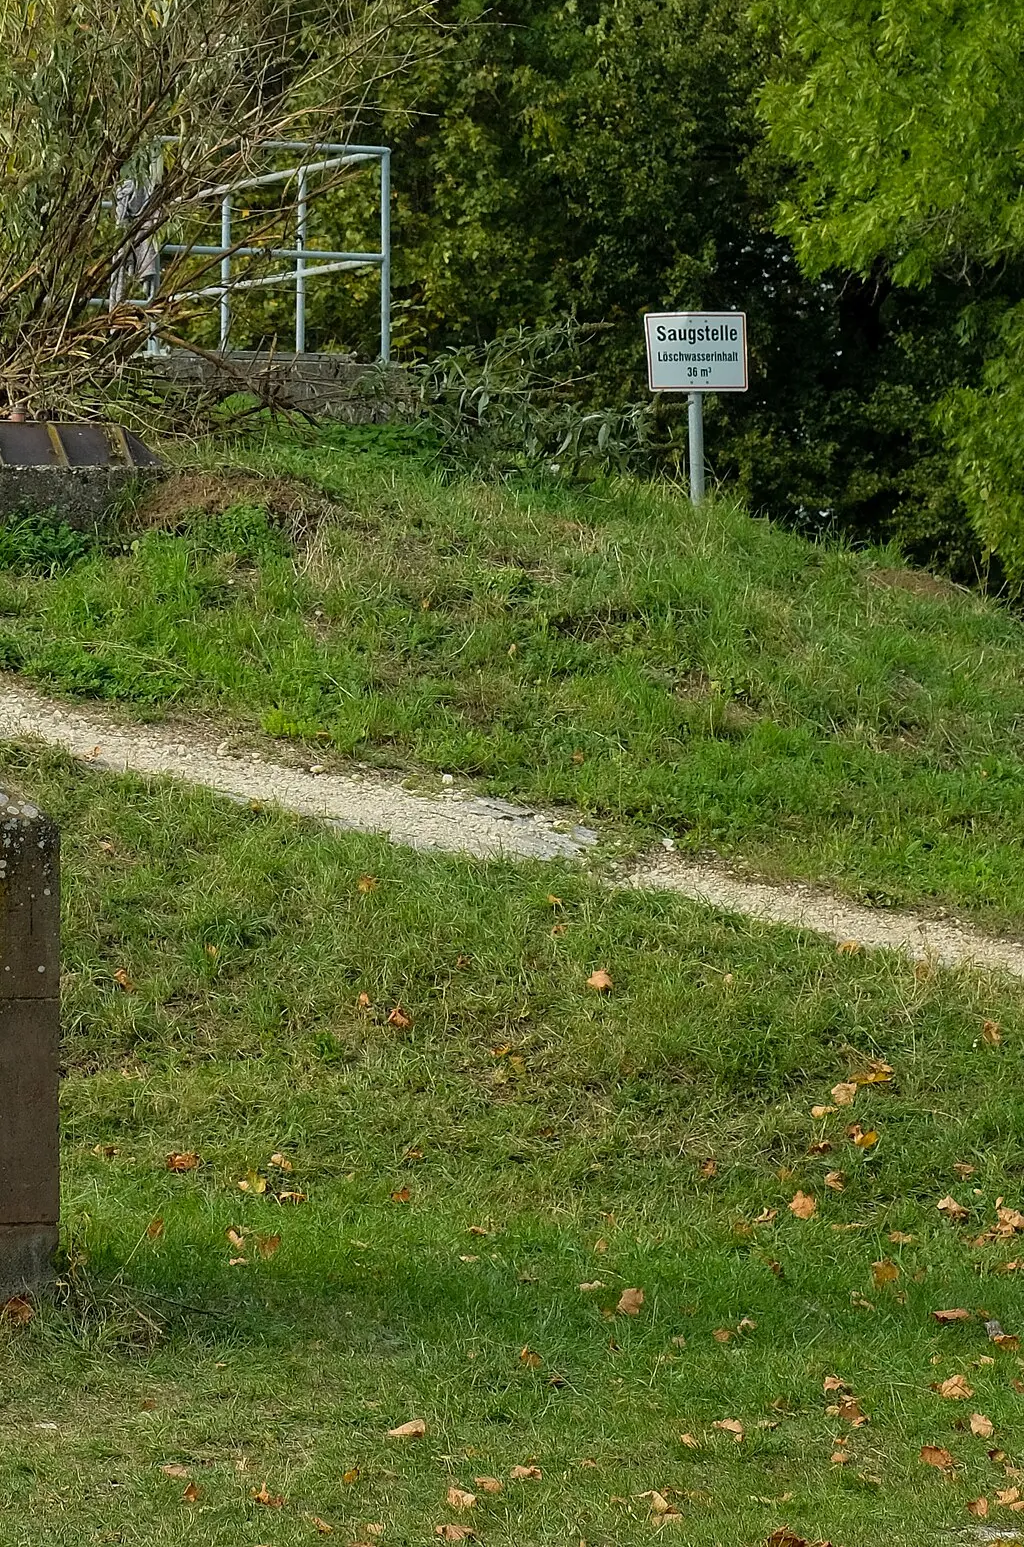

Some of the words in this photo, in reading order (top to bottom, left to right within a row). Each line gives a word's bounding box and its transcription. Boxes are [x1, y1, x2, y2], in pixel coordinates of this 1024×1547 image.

[657, 325, 738, 344] Saugstelle
[658, 351, 738, 362] Löschwasserinhalt
[687, 366, 698, 377] 36
[700, 367, 712, 377] m³
